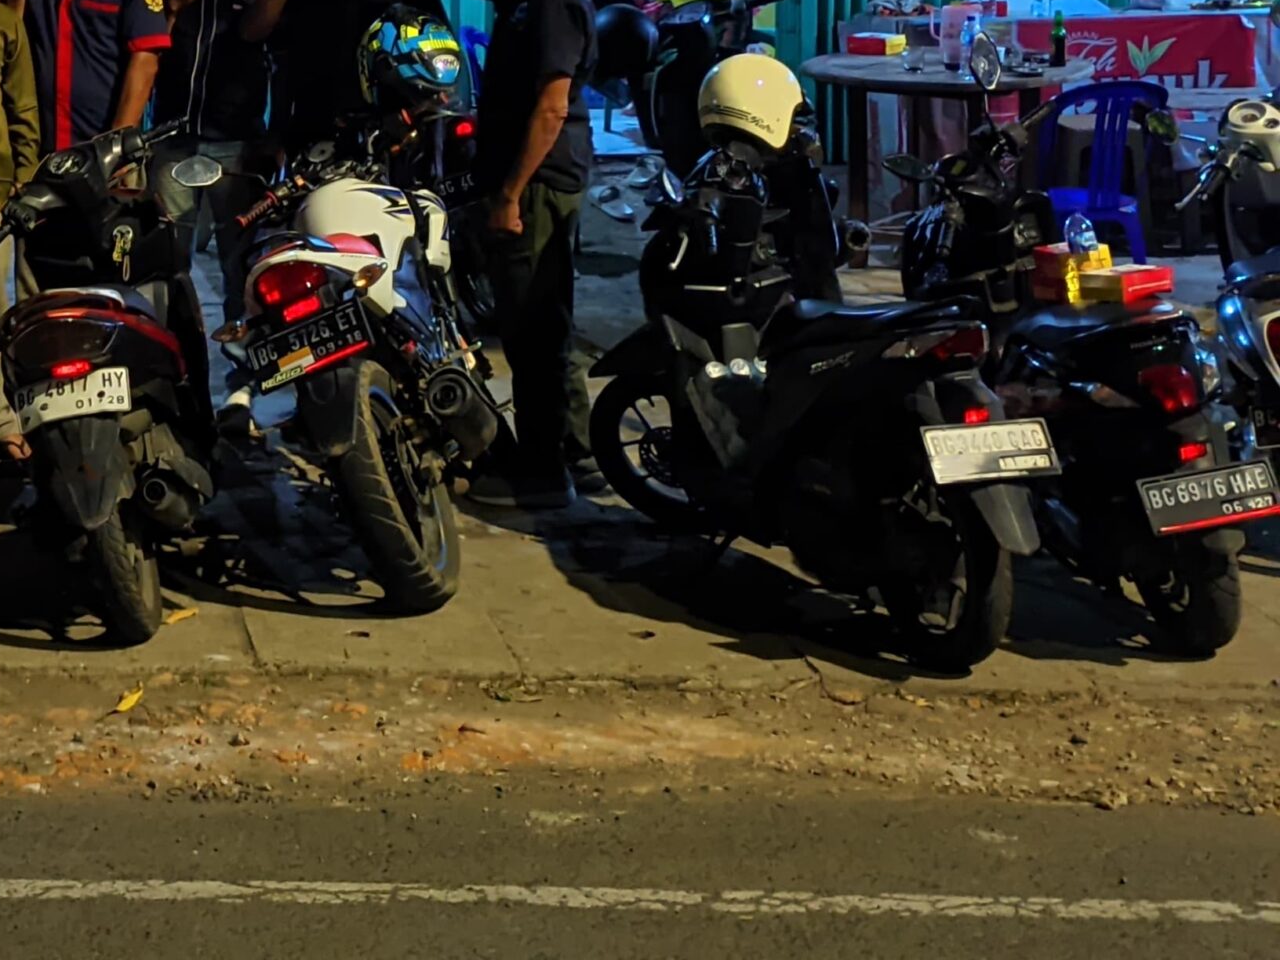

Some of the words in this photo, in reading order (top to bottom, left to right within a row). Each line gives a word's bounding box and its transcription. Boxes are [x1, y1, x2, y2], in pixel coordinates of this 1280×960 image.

[334, 306, 358, 331] ET
[16, 388, 35, 411] BG
[44, 375, 89, 398] 4817
[101, 372, 124, 388] HY
[929, 435, 956, 457] BG
[1148, 486, 1175, 510] BG
[1176, 478, 1227, 504] 6976
[1229, 468, 1269, 495] HAE
